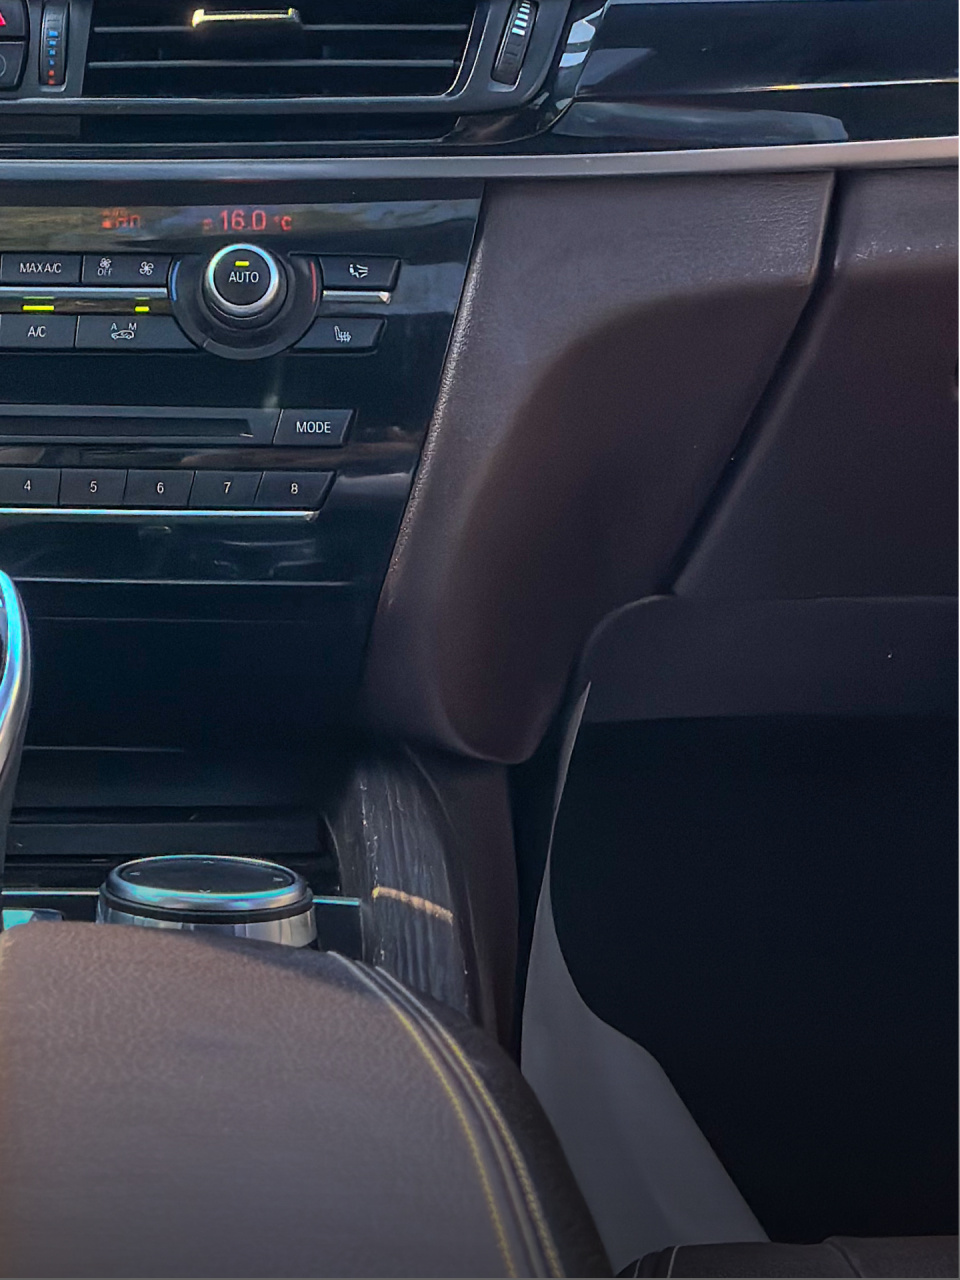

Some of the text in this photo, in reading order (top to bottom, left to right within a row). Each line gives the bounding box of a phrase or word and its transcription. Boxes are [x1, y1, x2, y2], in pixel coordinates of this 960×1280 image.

[19, 262, 62, 274] MAX A/C
[97, 267, 112, 276] OFF
[228, 271, 259, 283] AUTO
[27, 326, 46, 338] A/C
[110, 323, 137, 331] A M
[296, 421, 331, 434] MODE
[23, 479, 31, 491] 4
[90, 480, 97, 492] 5
[156, 482, 164, 494] 6
[224, 482, 231, 494] 7
[291, 482, 299, 494] 8
